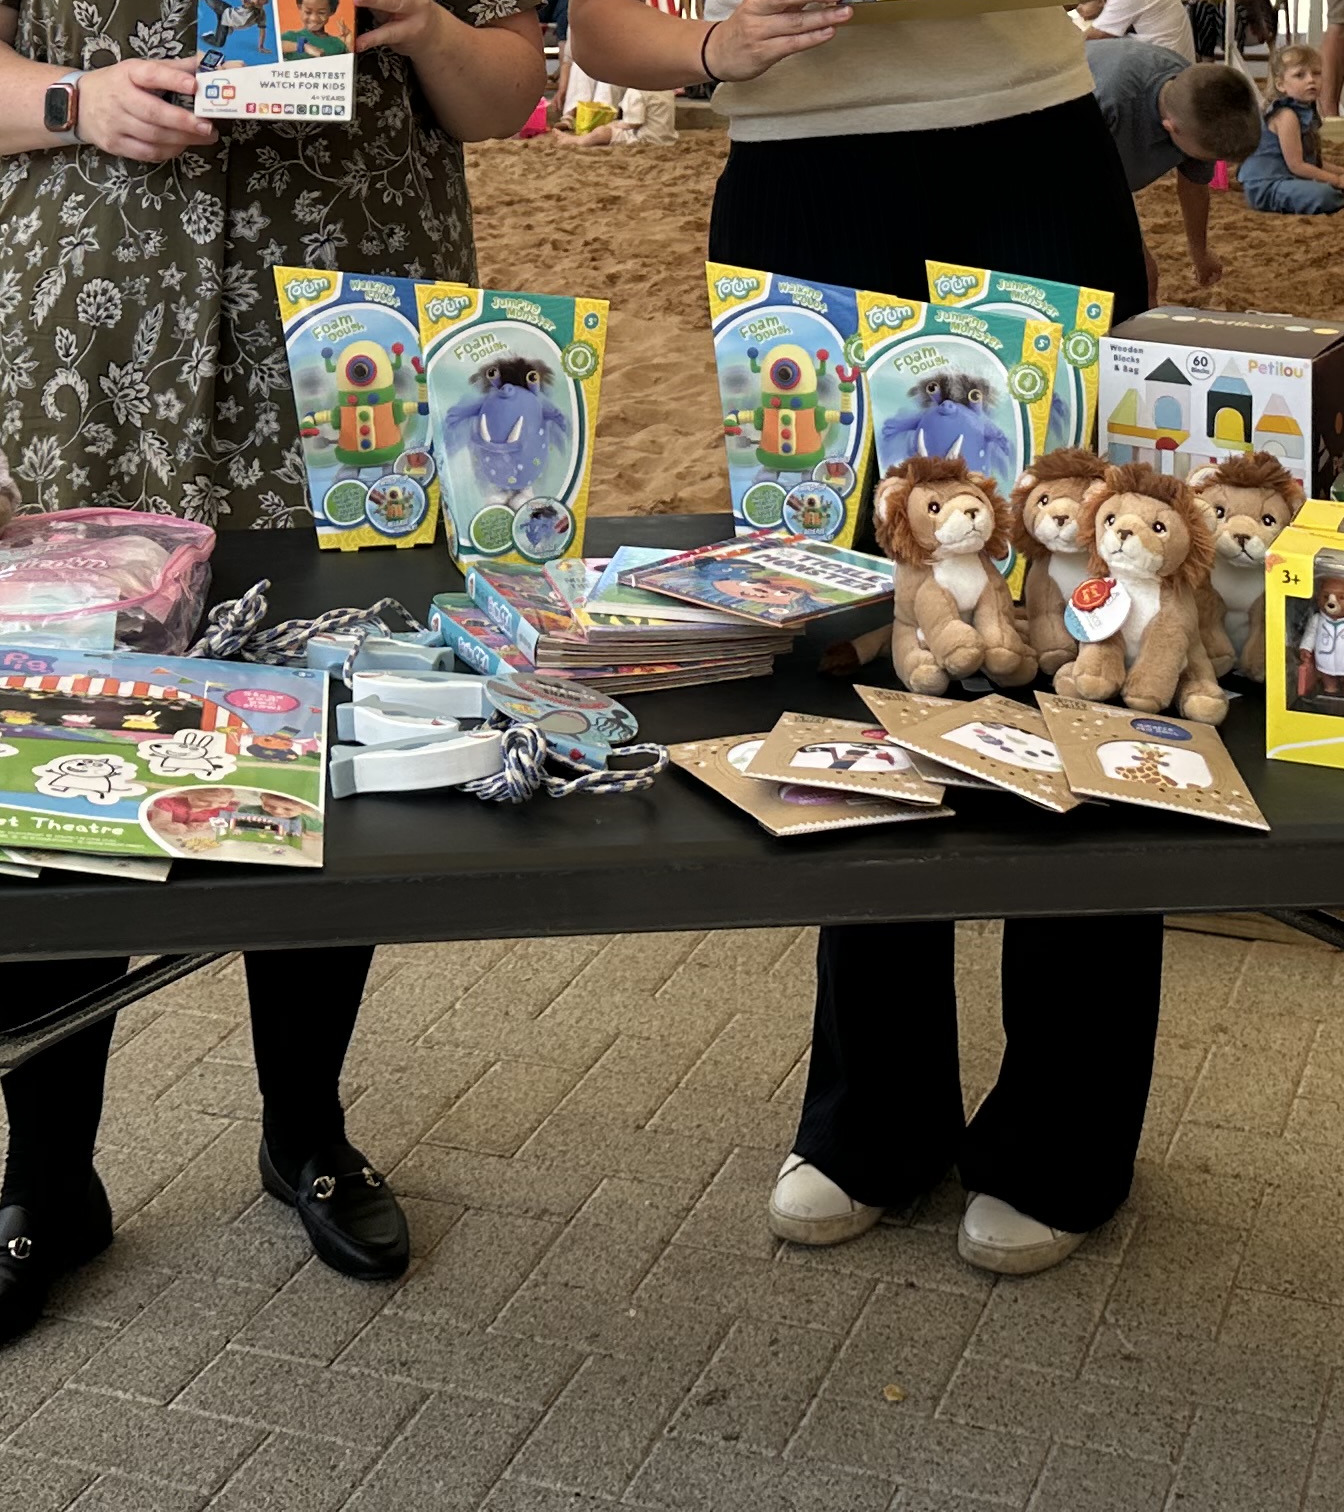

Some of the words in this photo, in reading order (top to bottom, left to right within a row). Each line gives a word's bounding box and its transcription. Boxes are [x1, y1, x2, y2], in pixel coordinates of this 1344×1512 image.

[271, 70, 290, 79] THE
[294, 71, 346, 80] SMARTEST
[260, 81, 295, 89] WATCH
[299, 81, 319, 90] FOR
[322, 82, 346, 91] KIDS
[1110, 344, 1143, 354] Wooden
[1113, 354, 1140, 364] Blocks
[1192, 356, 1208, 367] 60
[1123, 365, 1139, 375] Bag
[1248, 360, 1304, 378] Petilou
[754, 553, 878, 591] MONSTER
[1282, 570, 1301, 585] 3+
[4, 652, 53, 675] Pig
[30, 816, 124, 836] Theatre
